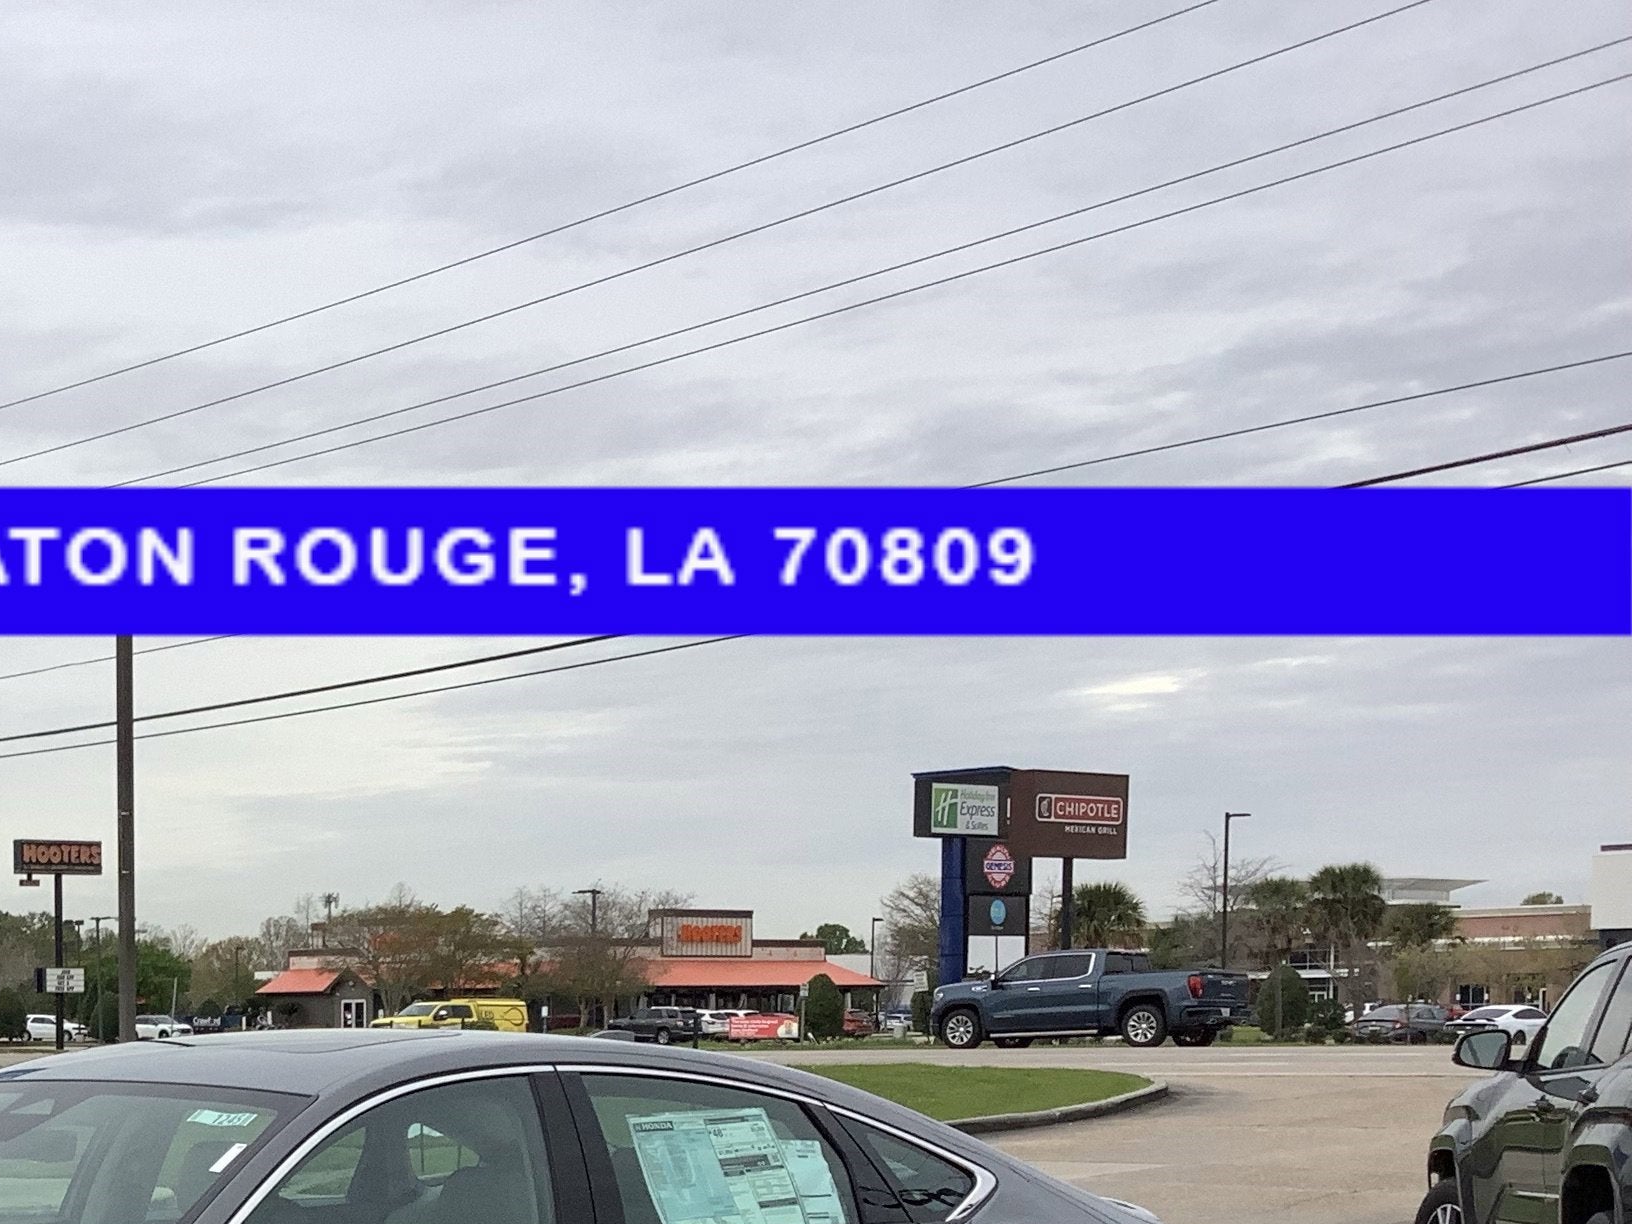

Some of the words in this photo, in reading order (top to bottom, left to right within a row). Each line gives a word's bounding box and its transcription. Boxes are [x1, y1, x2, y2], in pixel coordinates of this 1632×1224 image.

[960, 801, 995, 820] Express
[1056, 801, 1119, 818] CHIPOTLE
[1064, 825, 1096, 834] MEXICAN
[1097, 826, 1117, 835] GRILL
[23, 843, 101, 864] HOOTERS
[985, 862, 1013, 871] GENESIS
[641, 1121, 673, 1130] HONDA
